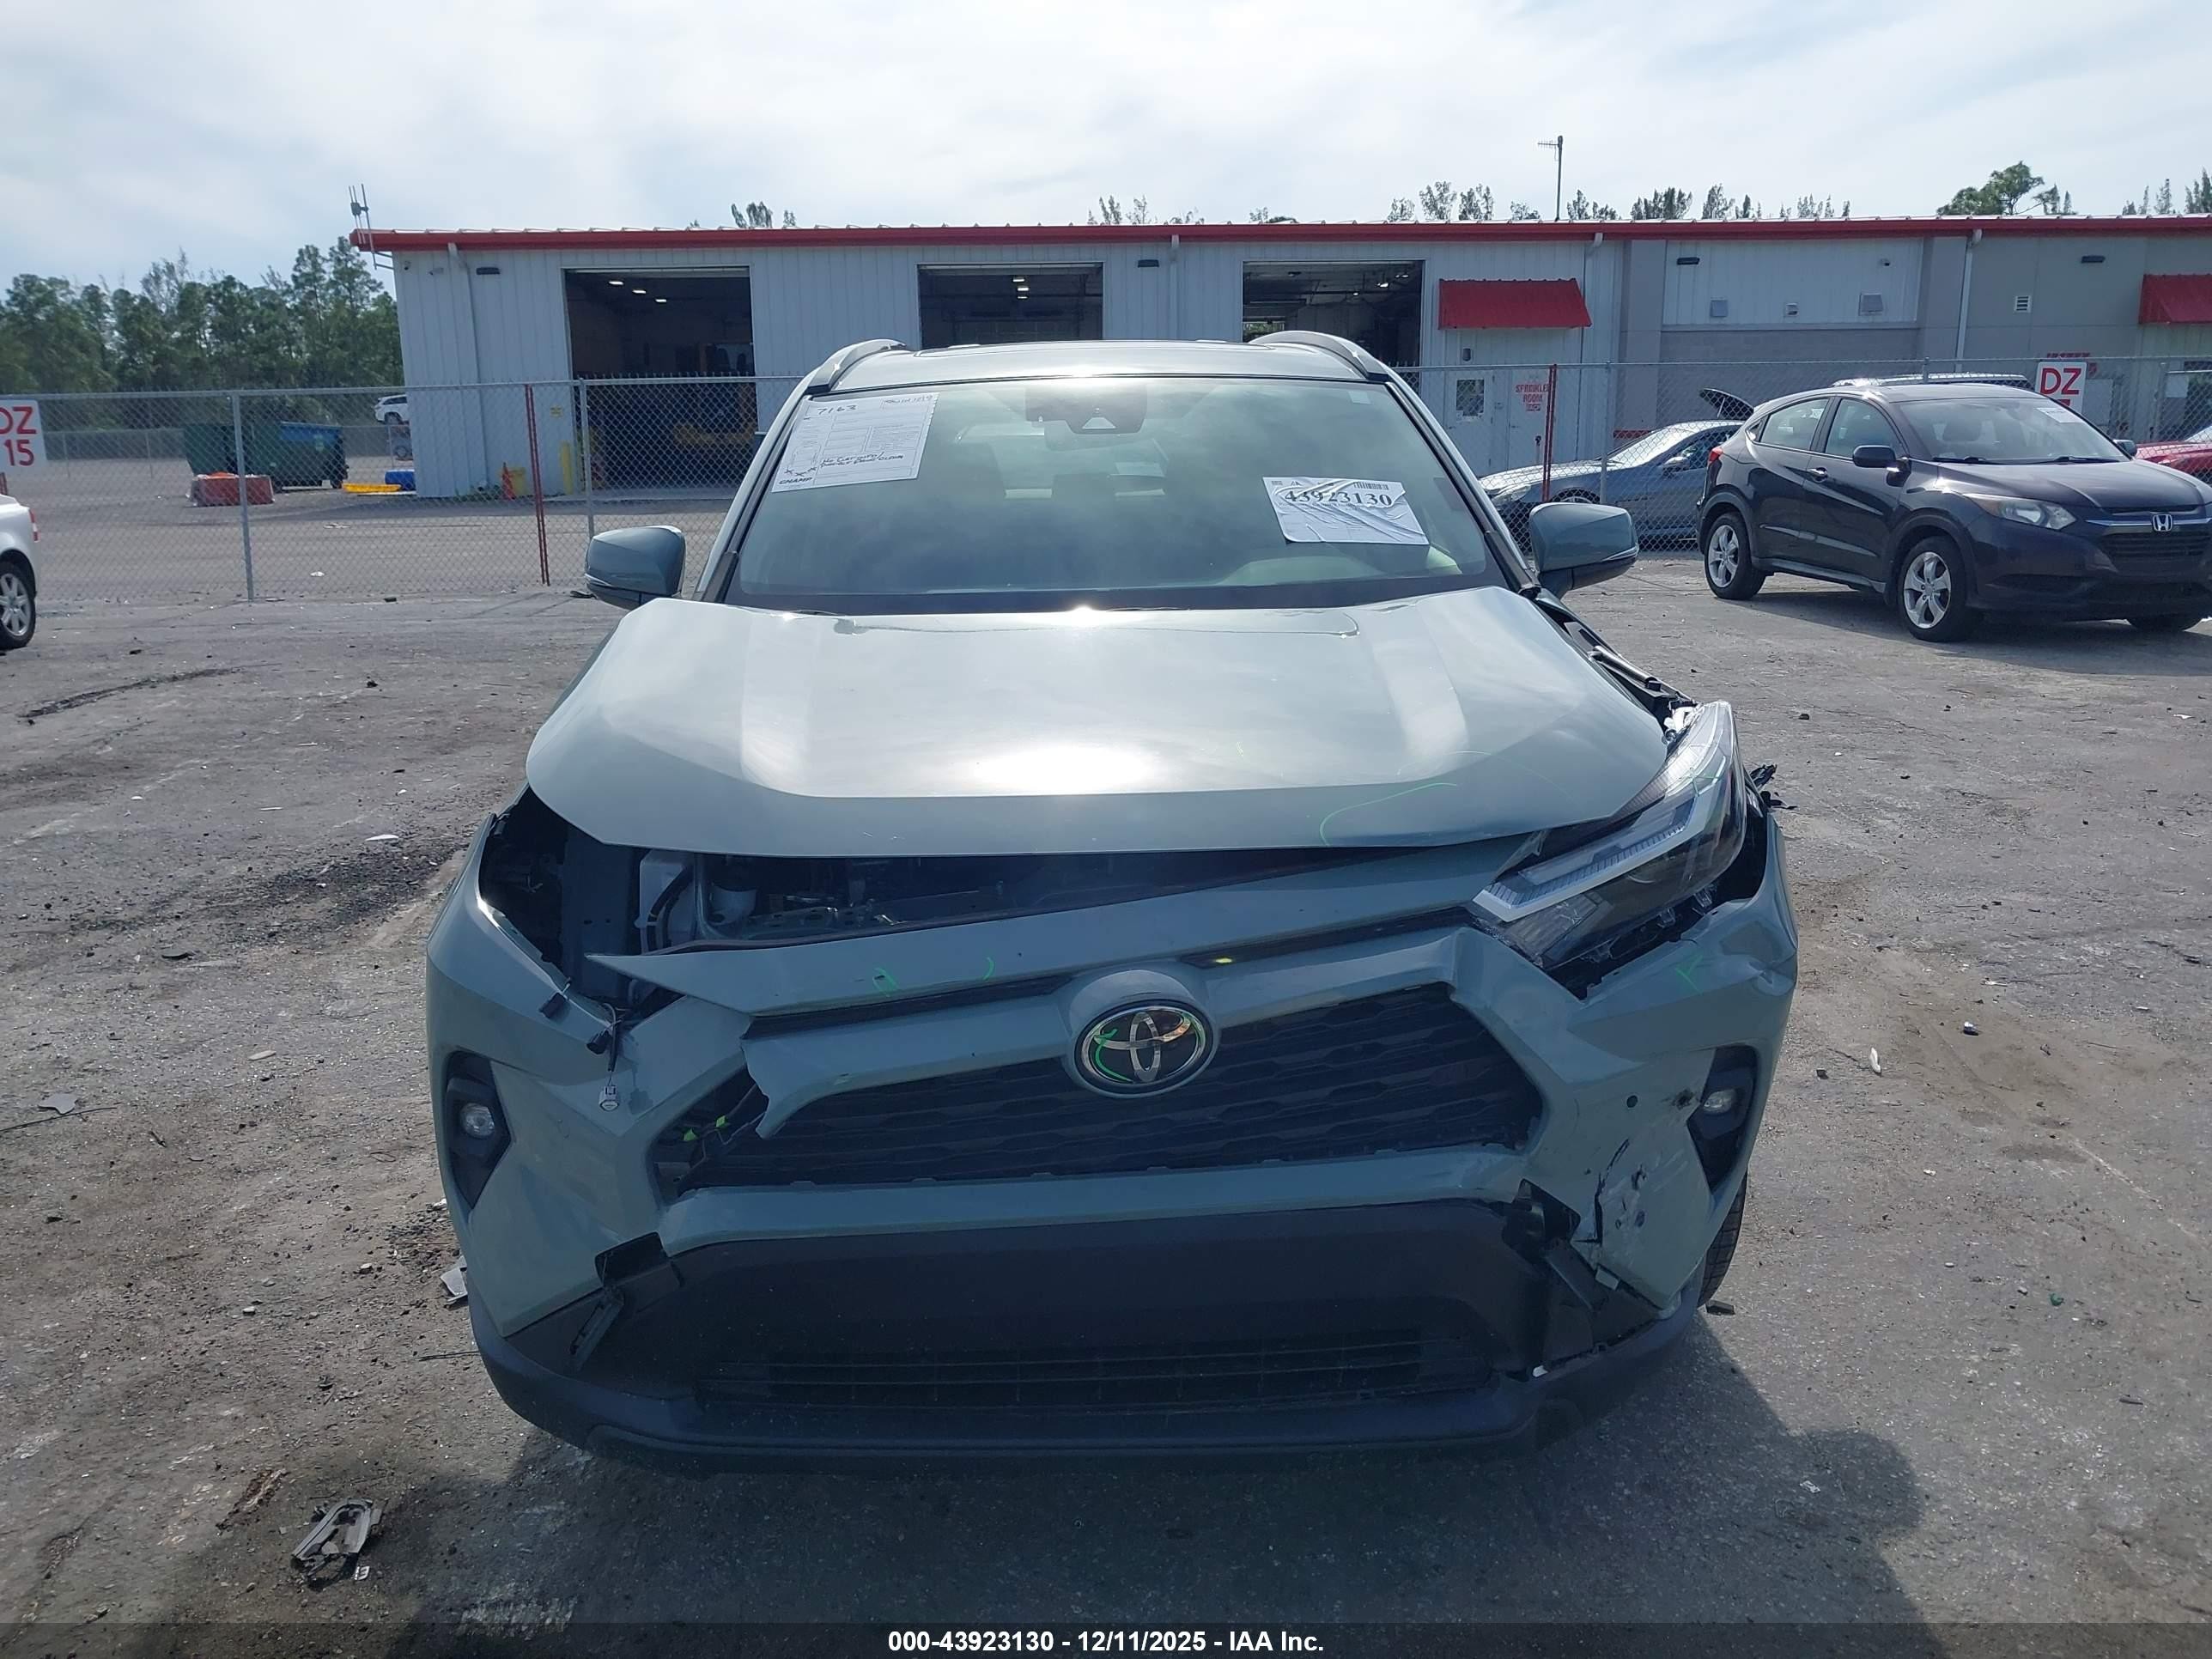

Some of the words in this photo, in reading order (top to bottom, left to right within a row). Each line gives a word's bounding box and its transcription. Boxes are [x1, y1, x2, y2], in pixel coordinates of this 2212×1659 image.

[2040, 368, 2081, 395] DZ
[817, 404, 857, 416] 7163
[4, 439, 34, 466] 15
[1285, 490, 1392, 506] 43923130
